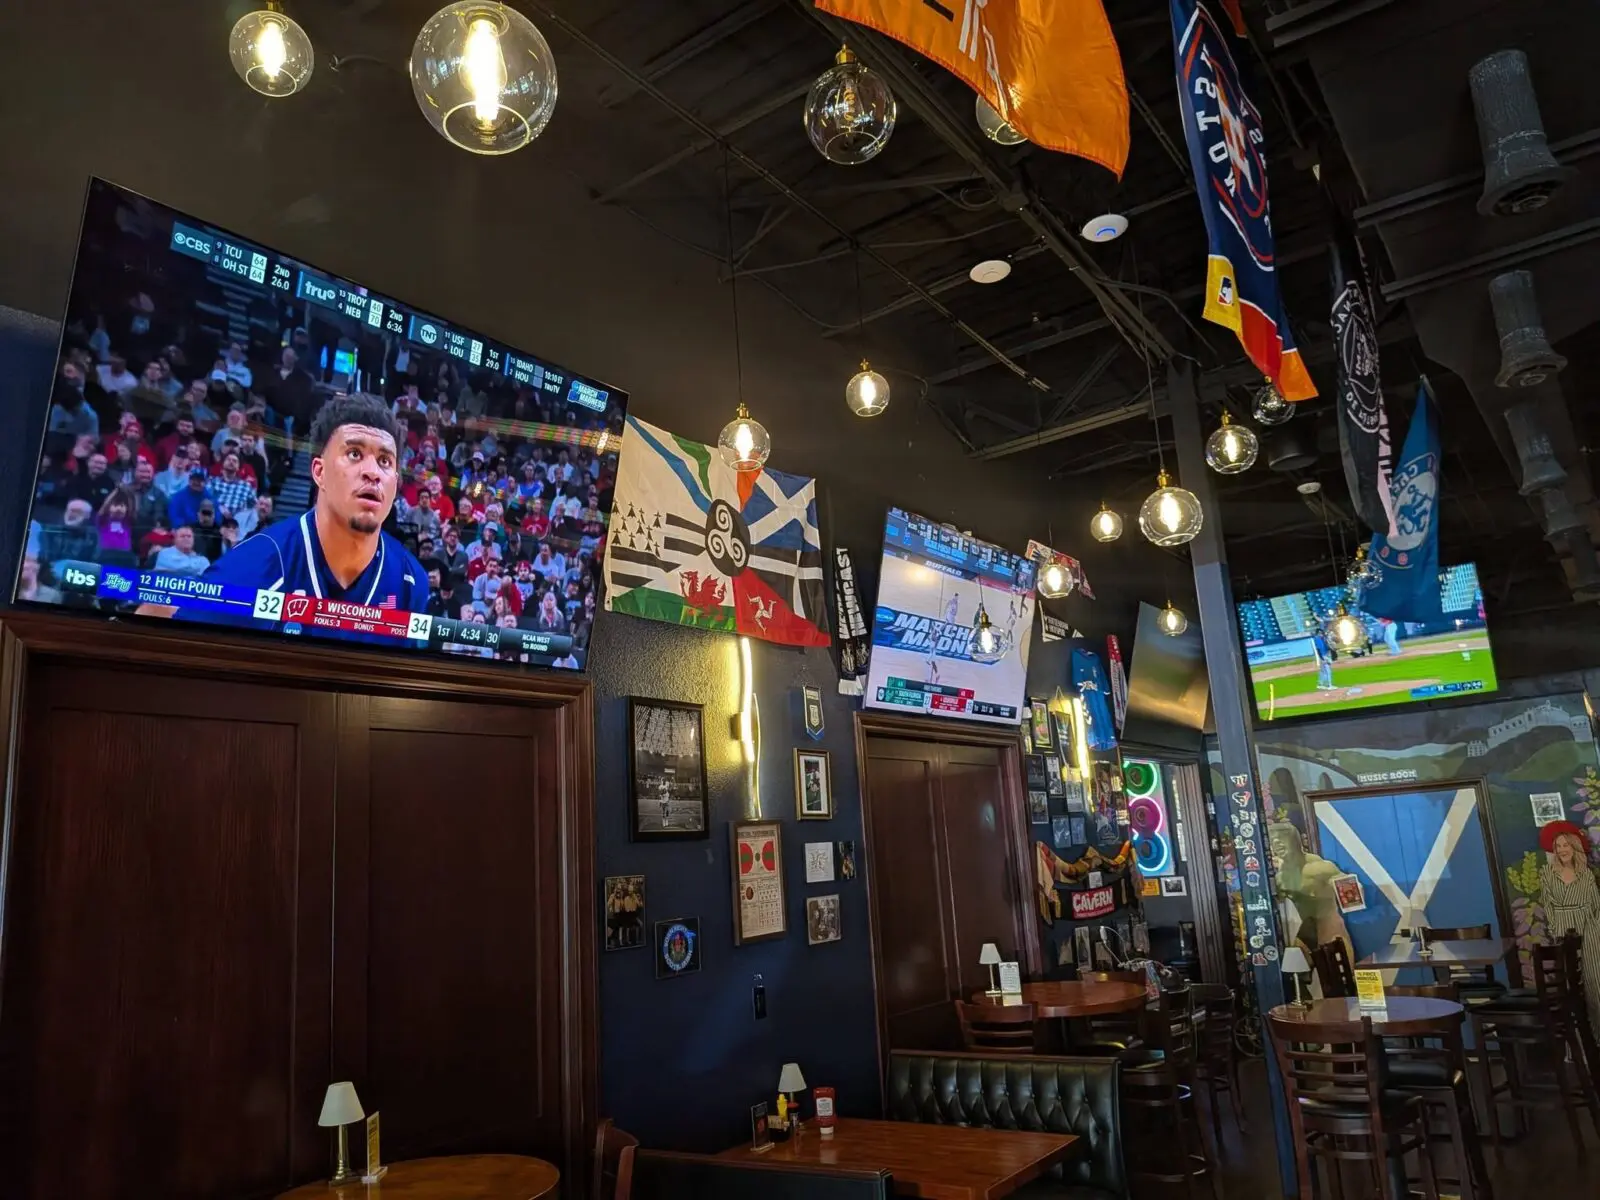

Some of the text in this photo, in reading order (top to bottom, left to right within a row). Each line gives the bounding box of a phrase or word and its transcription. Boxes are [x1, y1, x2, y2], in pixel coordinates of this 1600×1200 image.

[186, 236, 211, 255] CBS
[216, 241, 290, 279] 9 TCU 64 2ND
[223, 258, 236, 272] OH
[237, 264, 249, 277] ST
[251, 271, 263, 281] 64
[271, 276, 290, 291] 26.0
[339, 290, 404, 322] 13 TROY 40 2ND
[346, 305, 361, 319] NEB
[370, 314, 380, 325] 70
[387, 321, 403, 334] 6:36
[421, 330, 438, 341] TNT
[452, 334, 465, 346] USF
[472, 343, 482, 352] 27
[489, 349, 500, 360] 1ST
[450, 346, 464, 358] LOU
[471, 354, 480, 363] 35
[485, 359, 500, 371] 29.0
[515, 370, 529, 383] HOU
[516, 359, 534, 373] IDAHO
[544, 370, 558, 382] 10:10
[578, 384, 598, 398] MARCH
[579, 394, 608, 410] MADNESS
[66, 567, 96, 587] tbs
[925, 560, 963, 577] BUFFALO
[139, 574, 279, 614] 12 HIGH POINT 32
[317, 601, 498, 644] 5 WISCONSIN 34 1ST 4:34 30
[353, 622, 375, 633] BONUS
[390, 627, 406, 637] POSS
[894, 613, 974, 642] MARCH
[530, 644, 548, 653] ROUND
[536, 635, 551, 645] WEST
[1358, 770, 1416, 783] MUSIC ROOM
[1072, 888, 1114, 913] CAVERN
